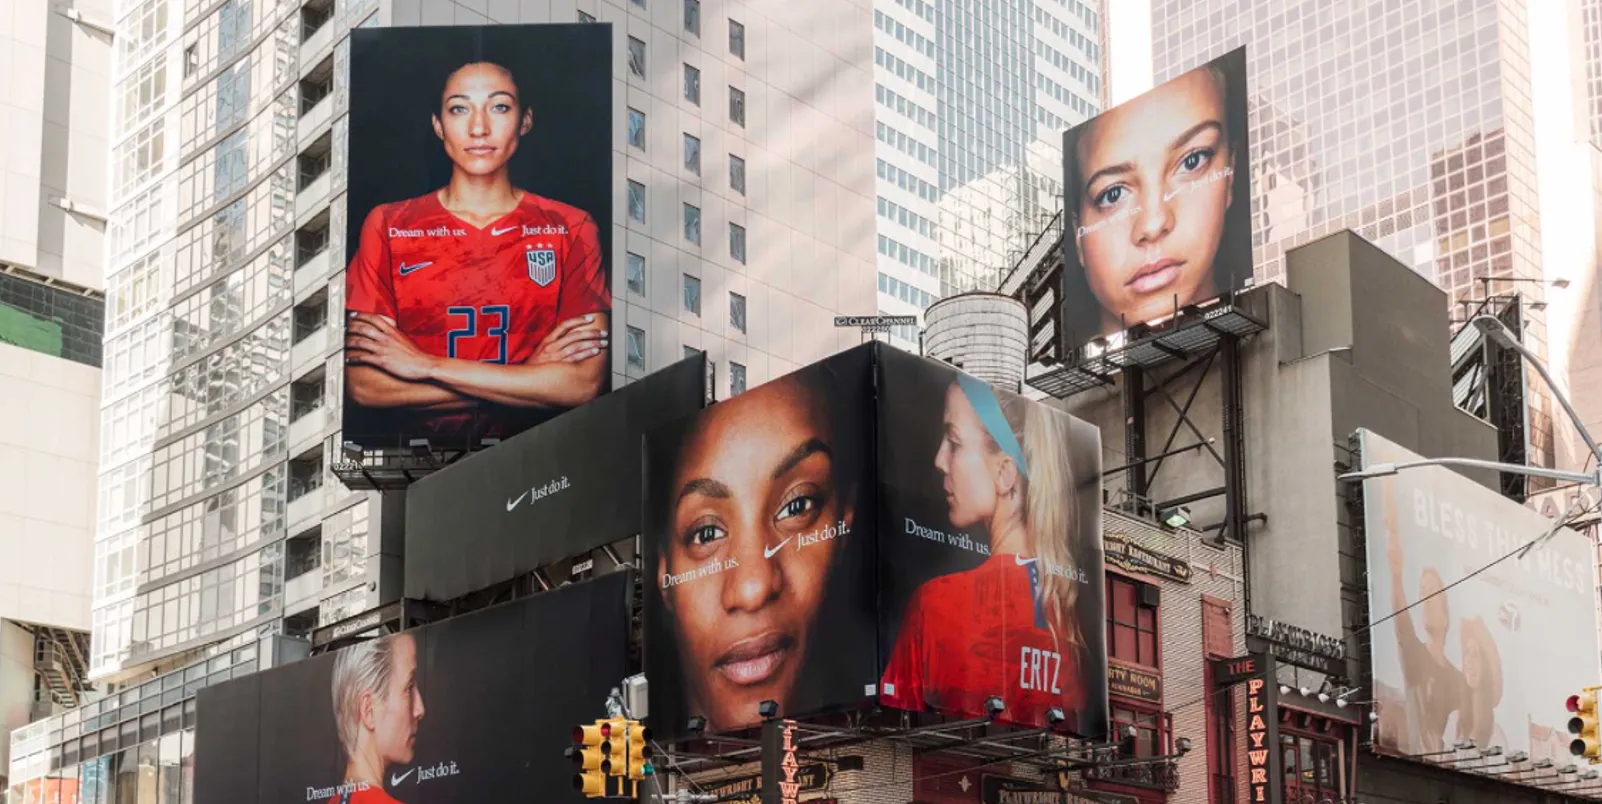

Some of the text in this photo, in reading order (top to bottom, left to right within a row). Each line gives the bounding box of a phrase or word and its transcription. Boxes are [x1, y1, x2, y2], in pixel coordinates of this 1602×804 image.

[389, 225, 467, 238] Dream with us.
[522, 224, 569, 237] Just do it.
[529, 251, 555, 266] USA
[448, 305, 510, 365] 23
[530, 476, 571, 504] Just do it.
[797, 520, 851, 551] Just do it.
[905, 517, 992, 556] Dream with us.
[1413, 487, 1478, 550] BLESS
[1537, 547, 1585, 595] MESS
[662, 558, 740, 588] Dream with us.
[1065, 566, 1079, 581] do
[1078, 568, 1089, 585] it.
[1020, 646, 1062, 695] ERTZ
[1227, 660, 1256, 674] THE
[416, 760, 461, 784] Just do it.
[306, 785, 336, 802] Dream
[336, 779, 358, 797] with
